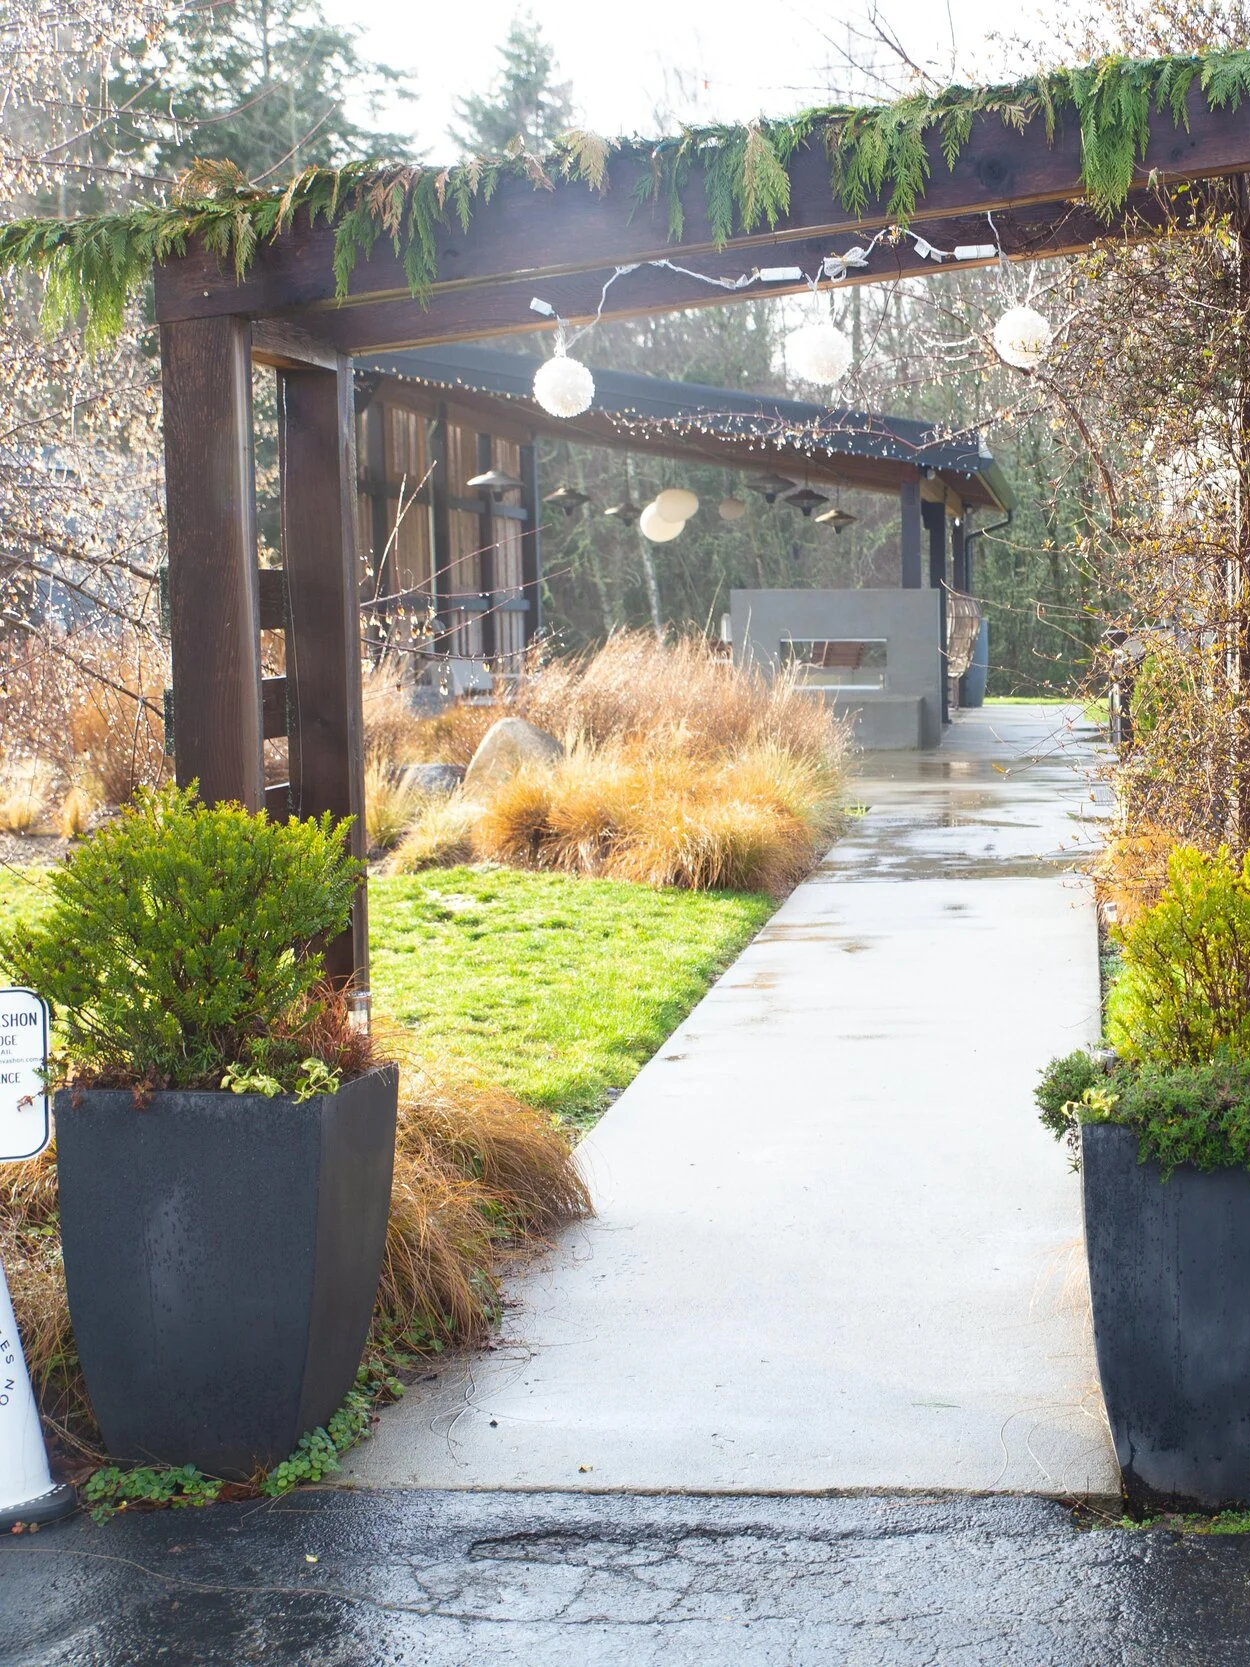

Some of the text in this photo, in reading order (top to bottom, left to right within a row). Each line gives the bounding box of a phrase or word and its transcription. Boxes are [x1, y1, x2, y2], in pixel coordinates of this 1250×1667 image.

[0, 1011, 38, 1028] SHON
[0, 1072, 21, 1084] NCE
[0, 1330, 15, 1364] ES
